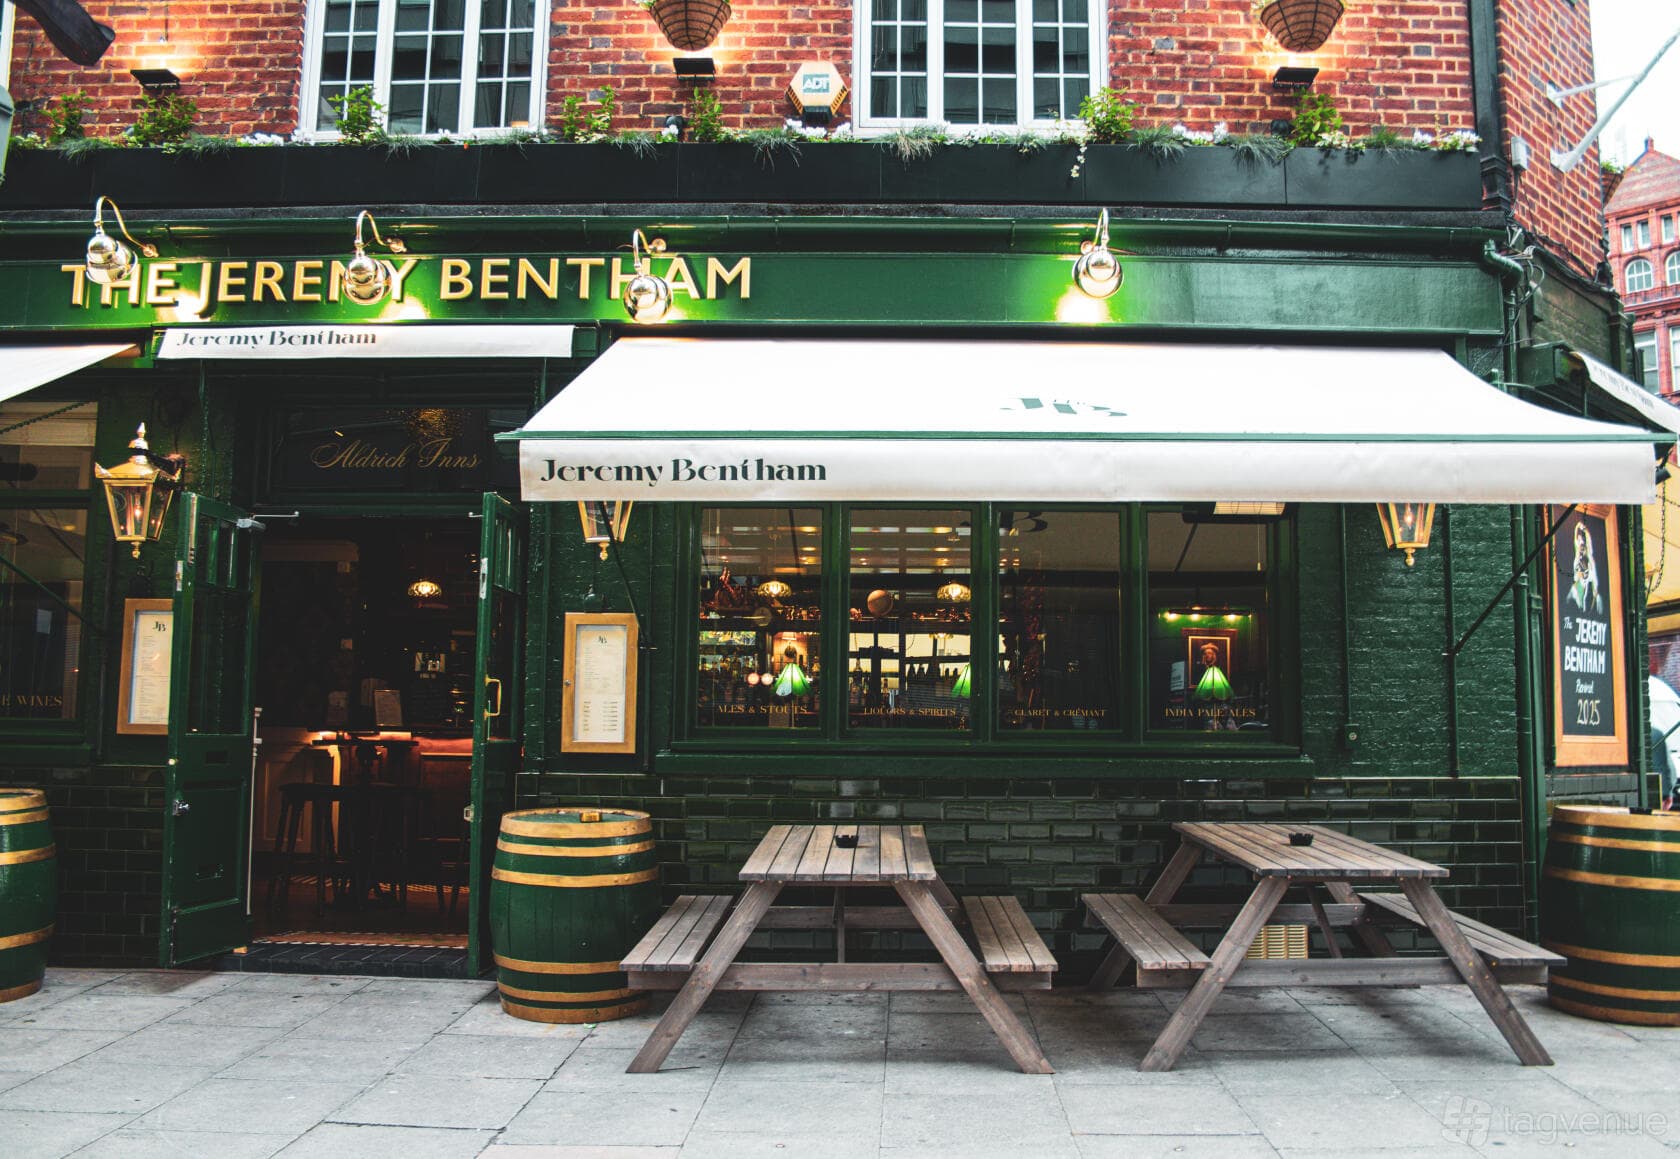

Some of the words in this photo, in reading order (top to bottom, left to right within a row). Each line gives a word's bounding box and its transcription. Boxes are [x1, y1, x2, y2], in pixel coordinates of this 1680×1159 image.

[803, 77, 829, 90] ADT
[61, 263, 177, 304] THE
[440, 257, 751, 299] BENTHAM
[177, 333, 263, 349] Jeremy
[269, 330, 376, 346] Bentham
[311, 440, 413, 468] Aldrich
[417, 438, 481, 468] Inns
[541, 458, 663, 487] Jeremy
[671, 457, 827, 482] Bentham
[1575, 617, 1607, 646] JEREMY
[1564, 645, 1606, 674] BENTHAM
[718, 704, 744, 713] ALES
[748, 705, 755, 713] &
[760, 704, 808, 714] STOUTS
[918, 707, 957, 717] SPIRITS
[1014, 708, 1050, 716] CLARET
[1165, 707, 1194, 717] INDIA
[1197, 707, 1225, 717] PALE
[1228, 707, 1257, 717] ALES
[1576, 699, 1601, 725] 2025
